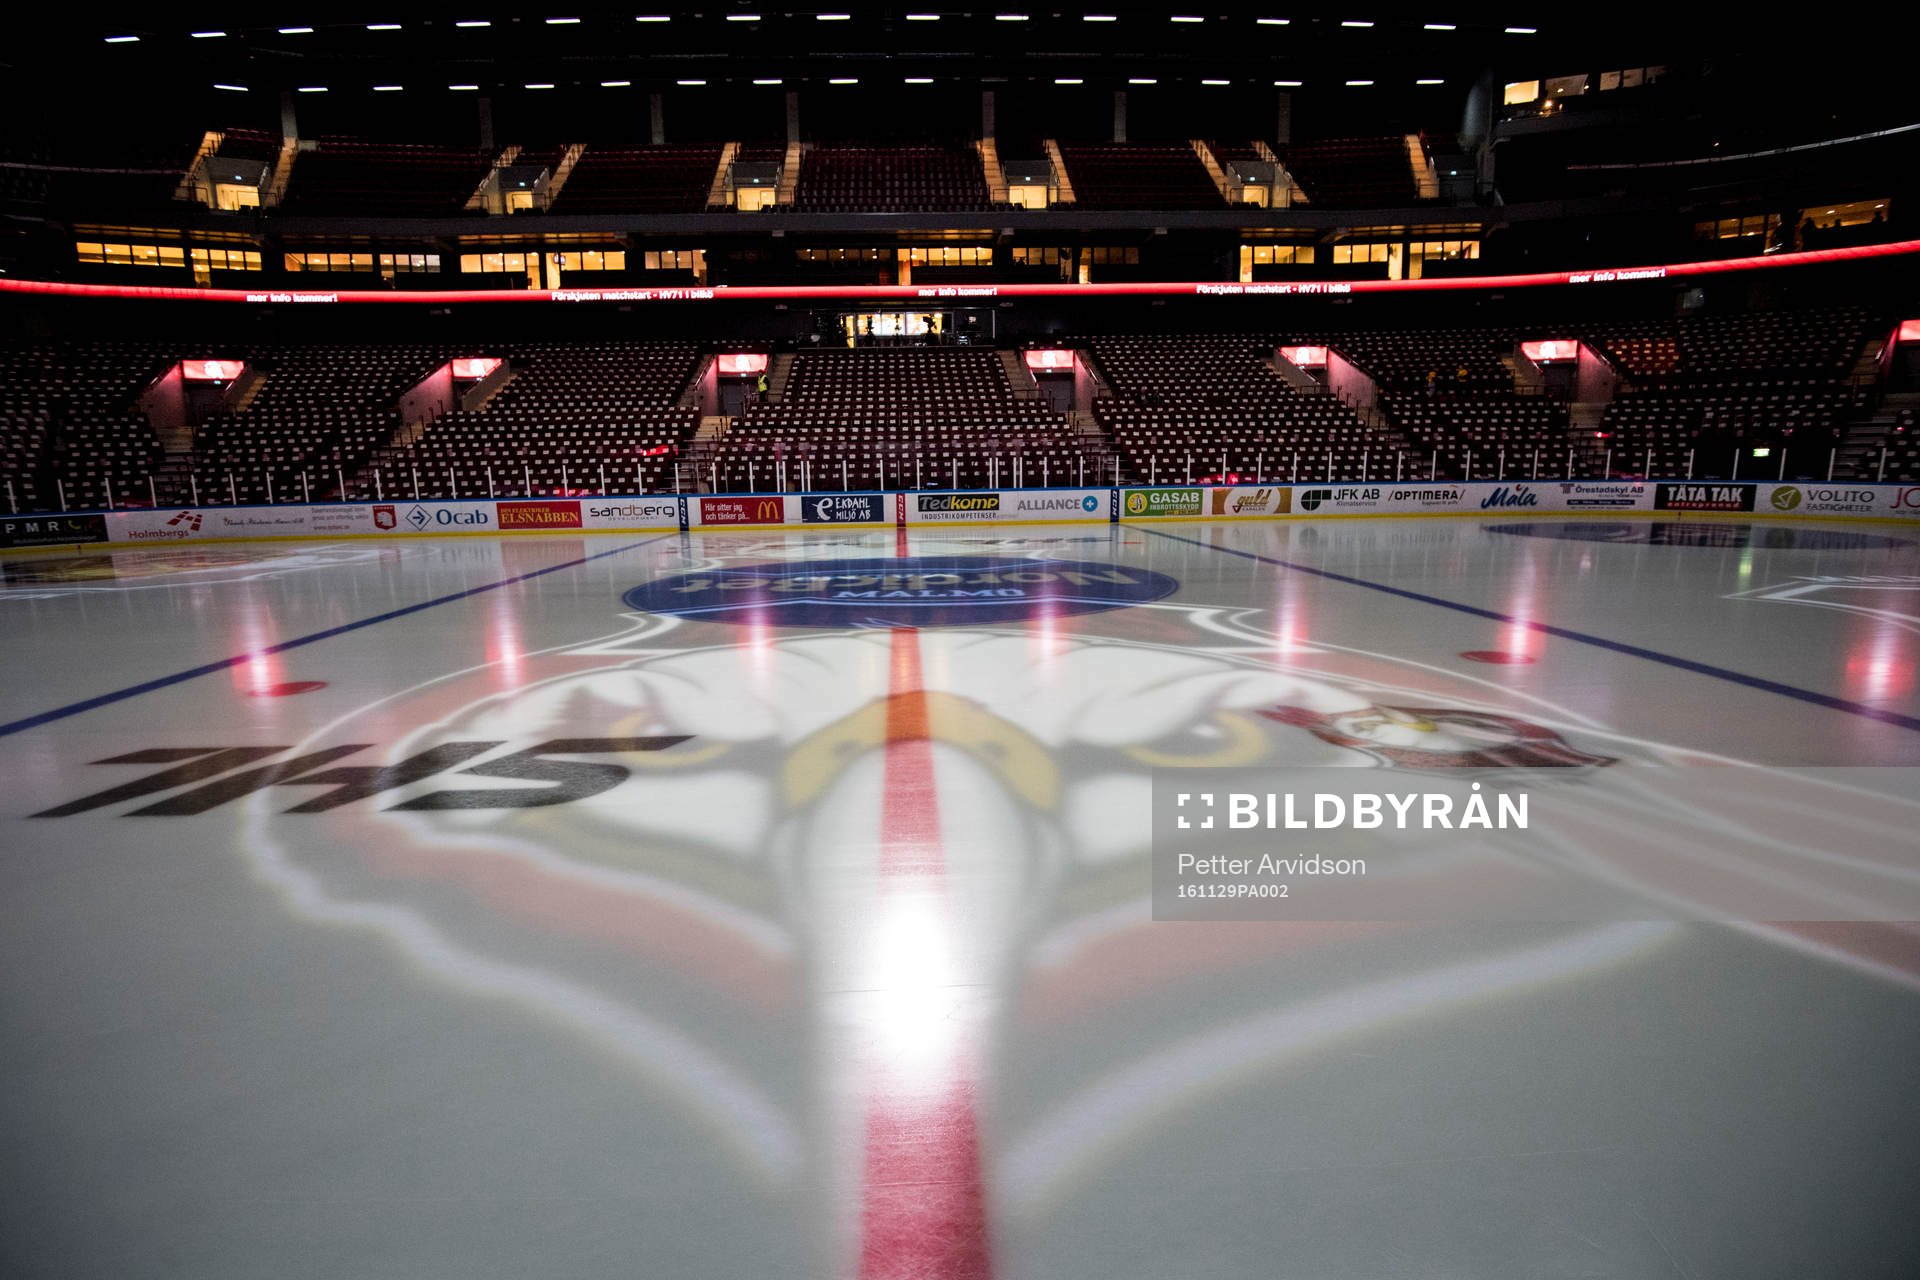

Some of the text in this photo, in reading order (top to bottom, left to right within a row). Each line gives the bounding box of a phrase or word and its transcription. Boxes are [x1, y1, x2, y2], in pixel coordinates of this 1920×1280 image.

[1569, 275, 1591, 283] mer
[1594, 272, 1615, 281] info
[938, 288, 956, 296] info
[958, 288, 997, 296] kommer!
[1245, 285, 1291, 293] matchstart
[246, 294, 268, 302] mer
[270, 293, 292, 302] info
[602, 291, 651, 301] matchstart
[659, 291, 683, 299] HV71
[1150, 492, 1200, 503] GASAB
[1334, 489, 1380, 500] JFK AB
[1667, 485, 1743, 502] TÄTA TAK
[1807, 490, 1875, 503] VOLITO
[705, 502, 742, 512] Här sitter jag
[835, 497, 870, 509] EKDAHL
[919, 496, 999, 511] Tedkomp
[1017, 499, 1081, 511] ALLIANCE
[1807, 503, 1872, 512] FASTIGHETER
[590, 504, 675, 518] sandberg
[706, 512, 717, 520] och
[718, 511, 736, 520] tänker
[859, 509, 871, 520] AB
[436, 509, 488, 525] Ocab
[501, 512, 579, 524] ELSNABBEN
[128, 528, 190, 539] Holmbergs
[671, 570, 1141, 594] NordicBet
